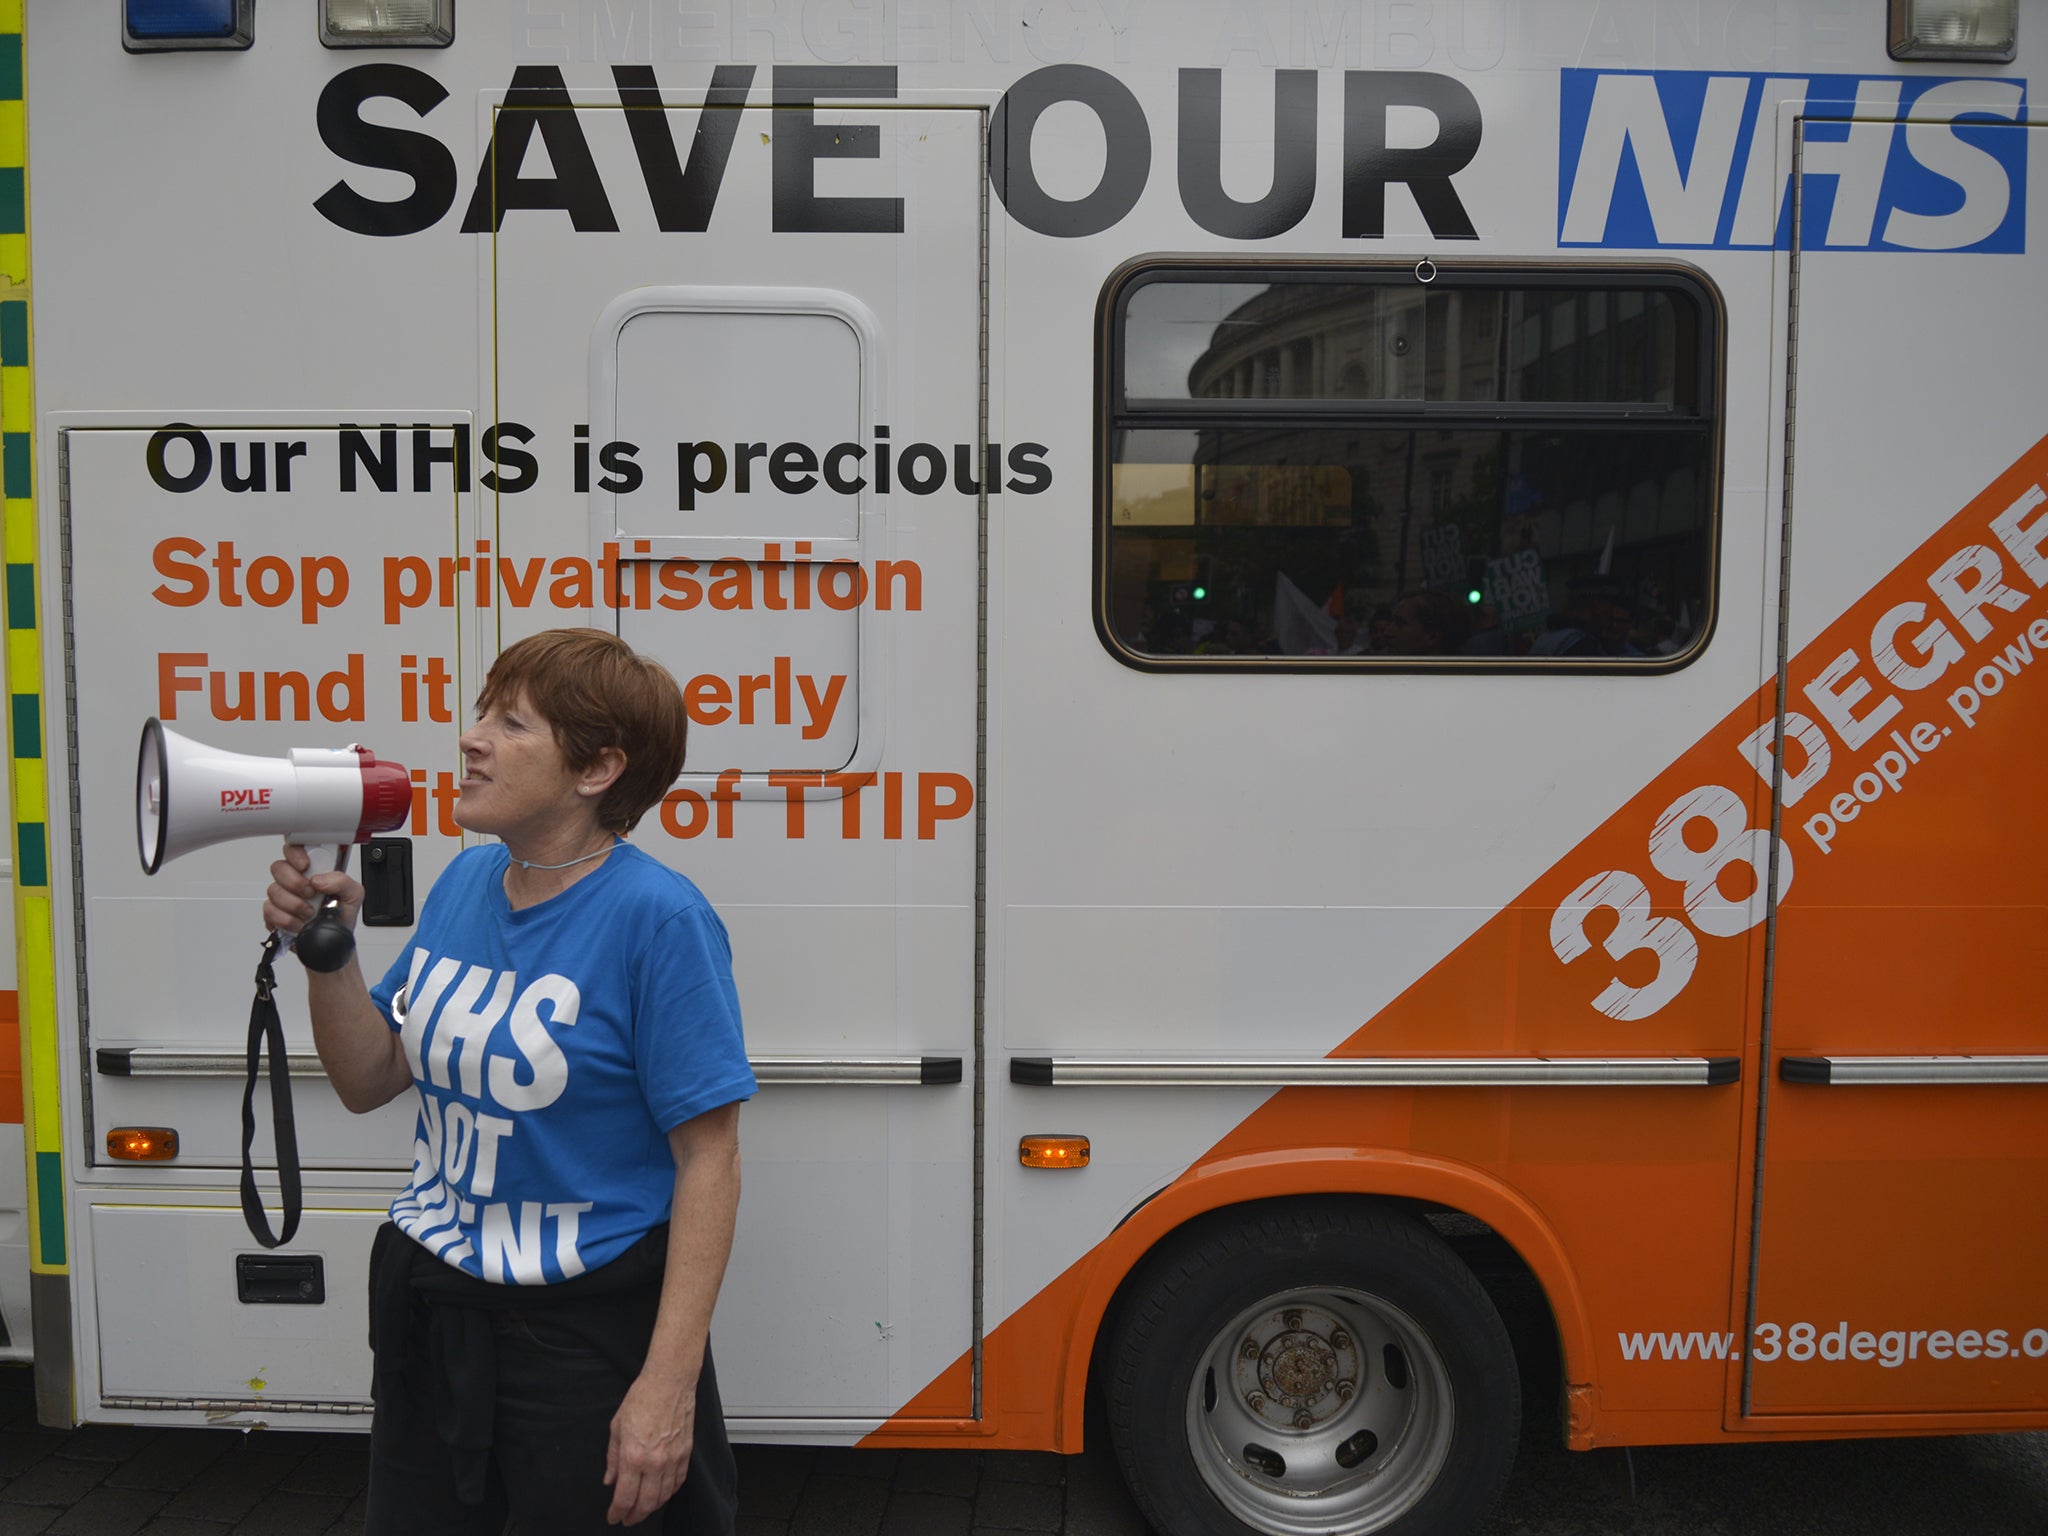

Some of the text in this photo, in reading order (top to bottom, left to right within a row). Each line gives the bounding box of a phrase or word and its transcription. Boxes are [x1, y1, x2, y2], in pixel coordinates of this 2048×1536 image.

[313, 63, 2025, 251] SAVE OUR NHS
[147, 422, 1053, 511] Our NHS is precious
[153, 537, 923, 625] Stop privatisation
[158, 652, 365, 722] Fund
[401, 654, 453, 723] it
[1803, 610, 2048, 855] people. powe
[221, 788, 271, 807] PYLE
[1549, 473, 2048, 1022] 38 DEGRE
[411, 768, 975, 841] it of TTIP
[400, 946, 581, 1112] NHS
[414, 1084, 514, 1198] NOT
